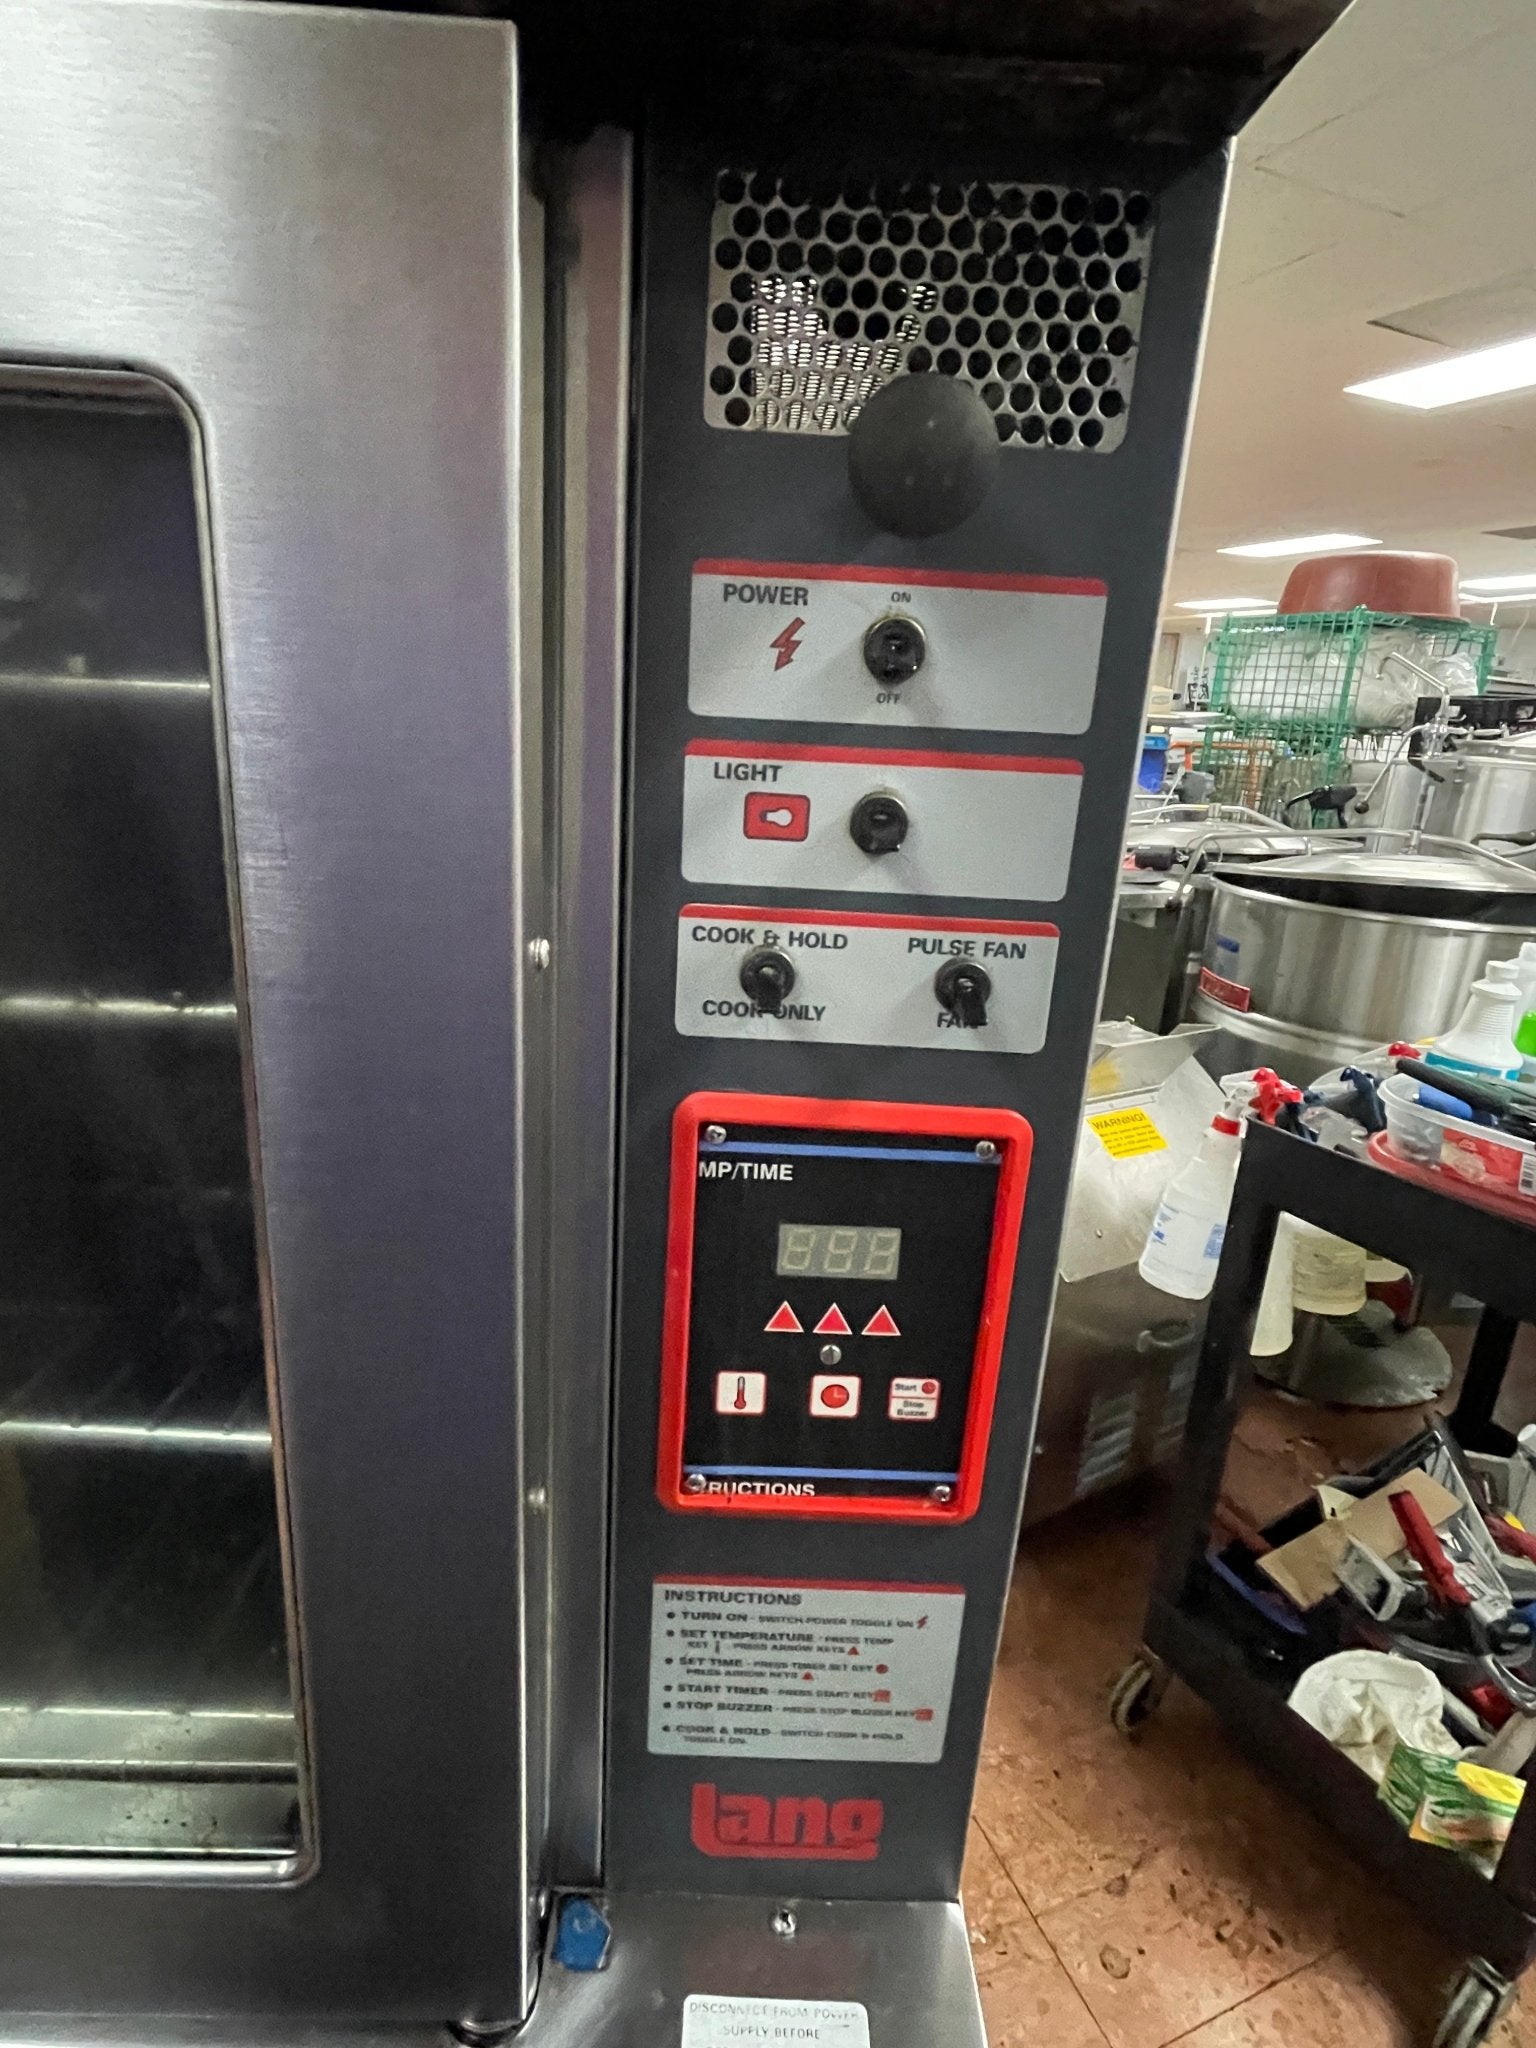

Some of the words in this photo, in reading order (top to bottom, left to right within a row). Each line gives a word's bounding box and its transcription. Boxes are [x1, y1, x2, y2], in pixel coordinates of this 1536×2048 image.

[723, 583, 809, 606] POWER
[891, 592, 912, 603] ON
[876, 693, 901, 704] OFF
[714, 762, 783, 782] LIGHT
[692, 925, 755, 945] COOK
[788, 930, 848, 950] HOLD
[908, 937, 976, 957] PULSE
[983, 941, 1027, 959] FAN
[699, 1161, 794, 1181] MP/TIME
[895, 1383, 917, 1391] Start
[897, 1408, 928, 1417] Buzzer
[664, 1589, 802, 1606] INSTRUCTIONS
[681, 1611, 722, 1621] TURN
[726, 1613, 748, 1622] ON
[758, 1615, 804, 1624] SWITCH
[805, 1617, 847, 1626] POWER
[851, 1618, 892, 1628] TOGGLE
[896, 1620, 914, 1628] ON
[680, 1629, 707, 1638] SET
[711, 1630, 813, 1643] TEMPERATURE
[824, 1636, 860, 1645] PRESS
[864, 1637, 895, 1646] TEMP
[771, 1644, 813, 1653] ARROW
[816, 1646, 846, 1654] KEYS
[679, 1656, 706, 1666] SET
[709, 1657, 742, 1667] TIME
[753, 1660, 788, 1669] PRESS
[678, 1683, 721, 1693] START
[725, 1684, 768, 1696] TIMER
[677, 1701, 713, 1711] STOP
[717, 1702, 772, 1713] BUZZER
[676, 1724, 714, 1734] COOK
[733, 1726, 771, 1736] HOLD
[689, 2002, 767, 2016] DISCONNECT
[773, 2005, 808, 2017] FROM
[723, 2025, 768, 2038] SUPPLY
[775, 2026, 820, 2040] BEFORE
